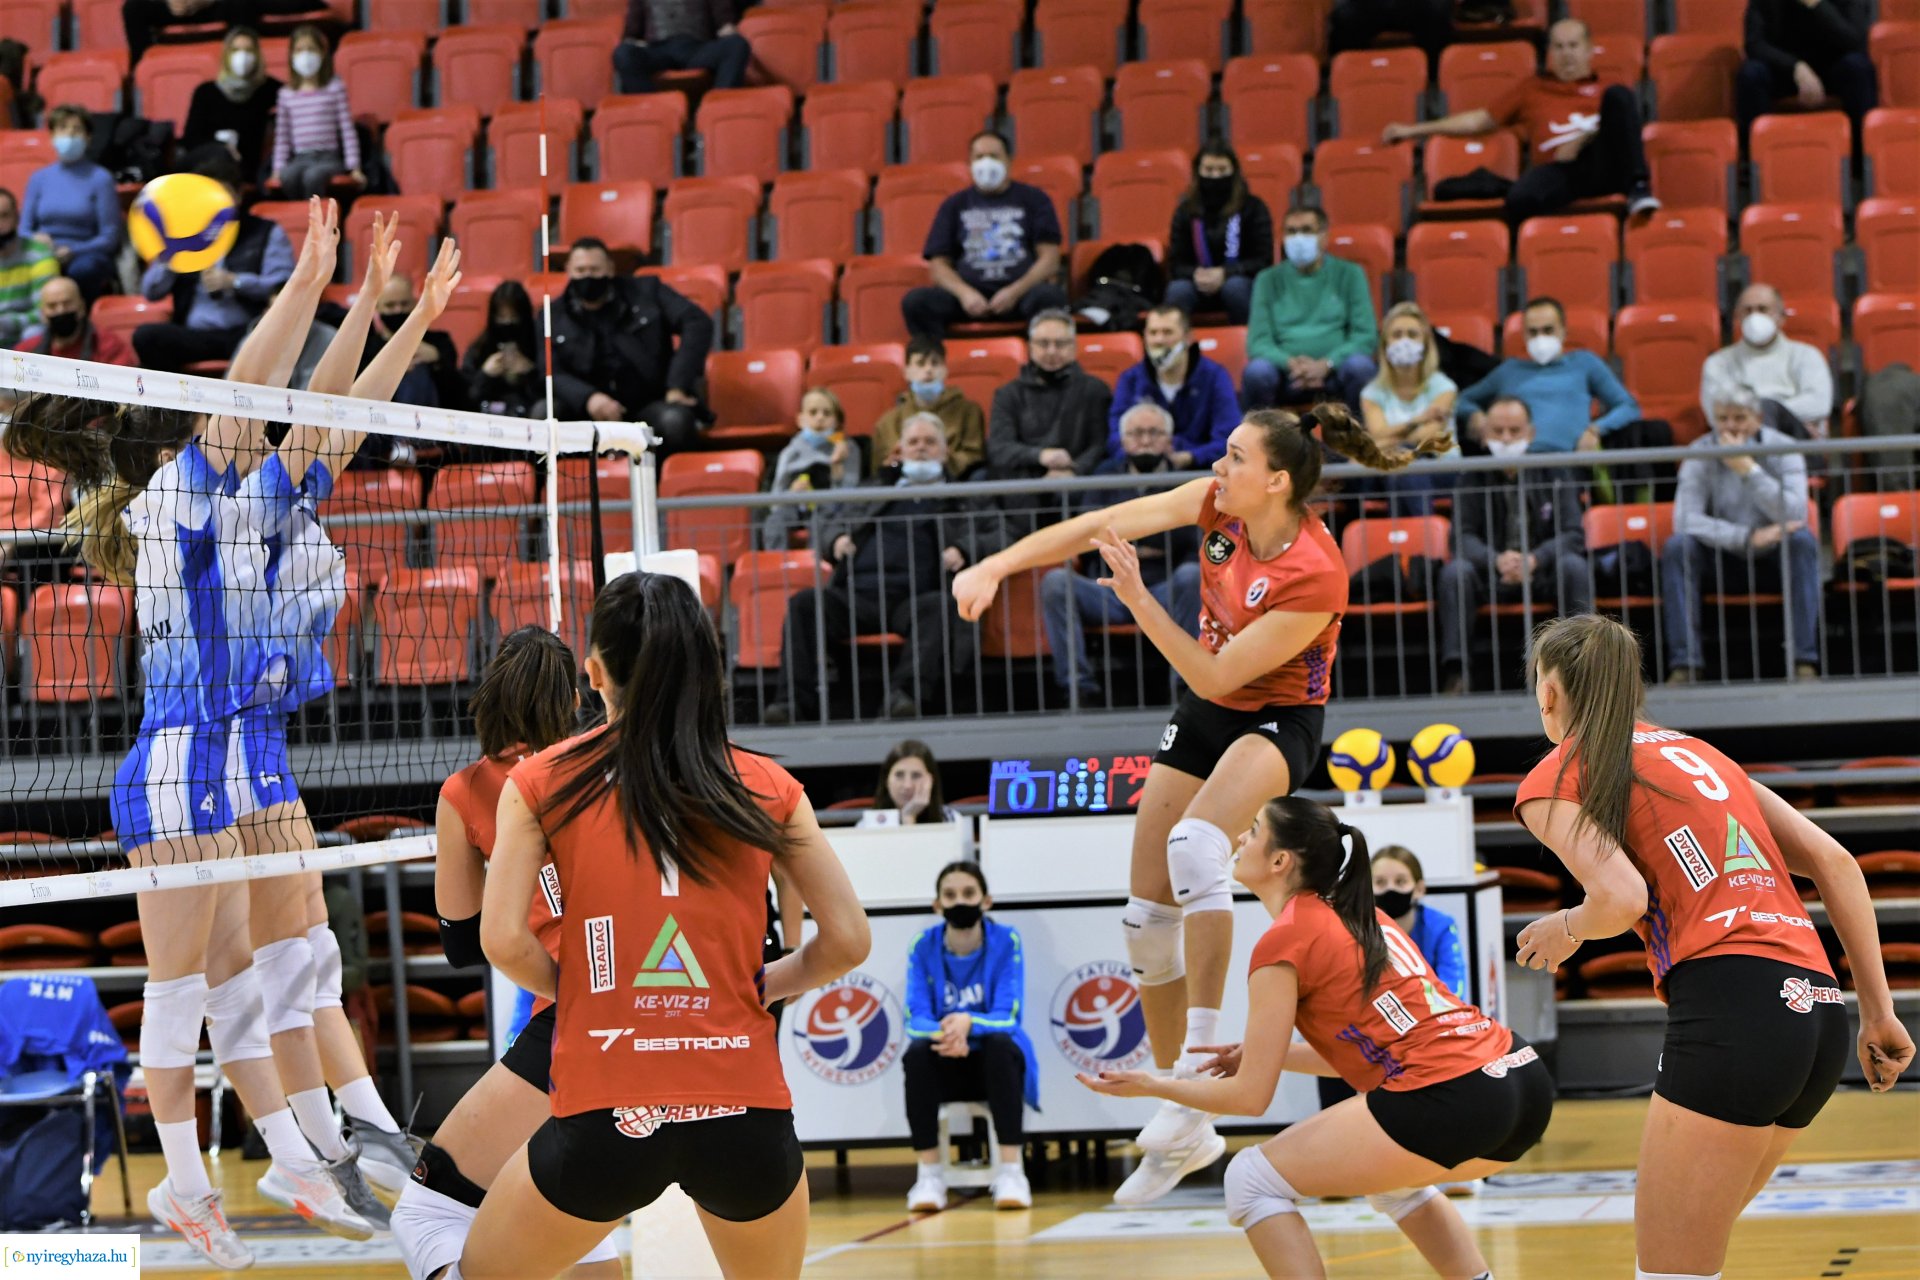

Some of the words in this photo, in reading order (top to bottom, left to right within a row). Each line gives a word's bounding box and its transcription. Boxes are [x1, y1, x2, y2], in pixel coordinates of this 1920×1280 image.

[1659, 746, 1729, 801] 9
[200, 792, 216, 814] 4
[1008, 776, 1036, 811] 0
[1675, 832, 1710, 884] STRABAG
[545, 867, 562, 911] RABAG
[595, 920, 609, 988] STRABAG
[1077, 963, 1132, 980] FATUM
[633, 994, 690, 1010] KE-VIZ
[691, 995, 710, 1010] 21
[1813, 988, 1845, 1004] REVE
[633, 1035, 750, 1052] BESTRONG
